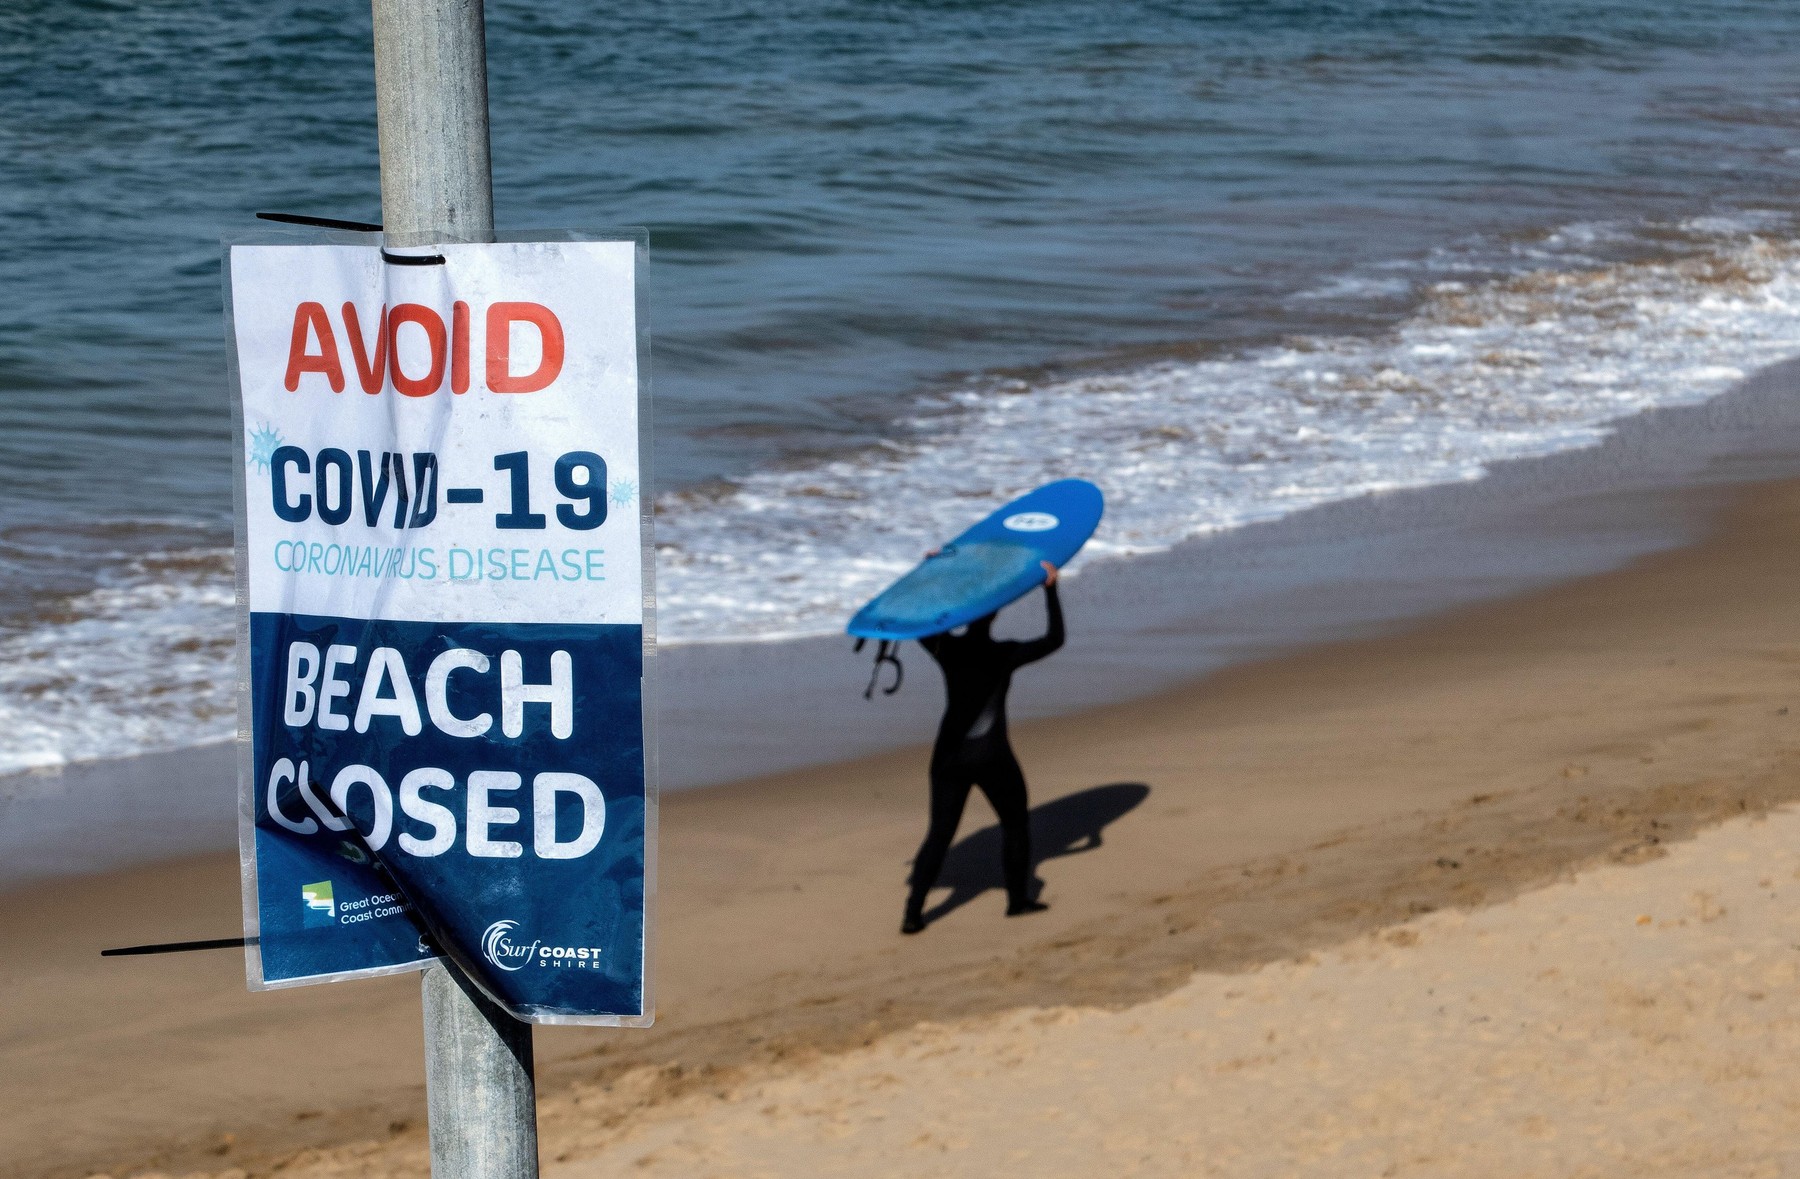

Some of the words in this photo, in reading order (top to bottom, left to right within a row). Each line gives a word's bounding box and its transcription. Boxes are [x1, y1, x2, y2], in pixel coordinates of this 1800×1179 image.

[284, 301, 565, 398] AVOID
[271, 446, 608, 531] COVID-19
[274, 540, 437, 581] CORONAVIRUS
[448, 548, 606, 581] DISEASE
[284, 641, 573, 740] BEACH
[267, 757, 606, 860] CLOSED
[340, 897, 370, 912] Great
[371, 892, 403, 905] Ocean
[341, 910, 373, 925] Coast
[497, 937, 541, 966] Surf
[539, 947, 602, 959] COAST
[539, 959, 600, 969] SHIRE
